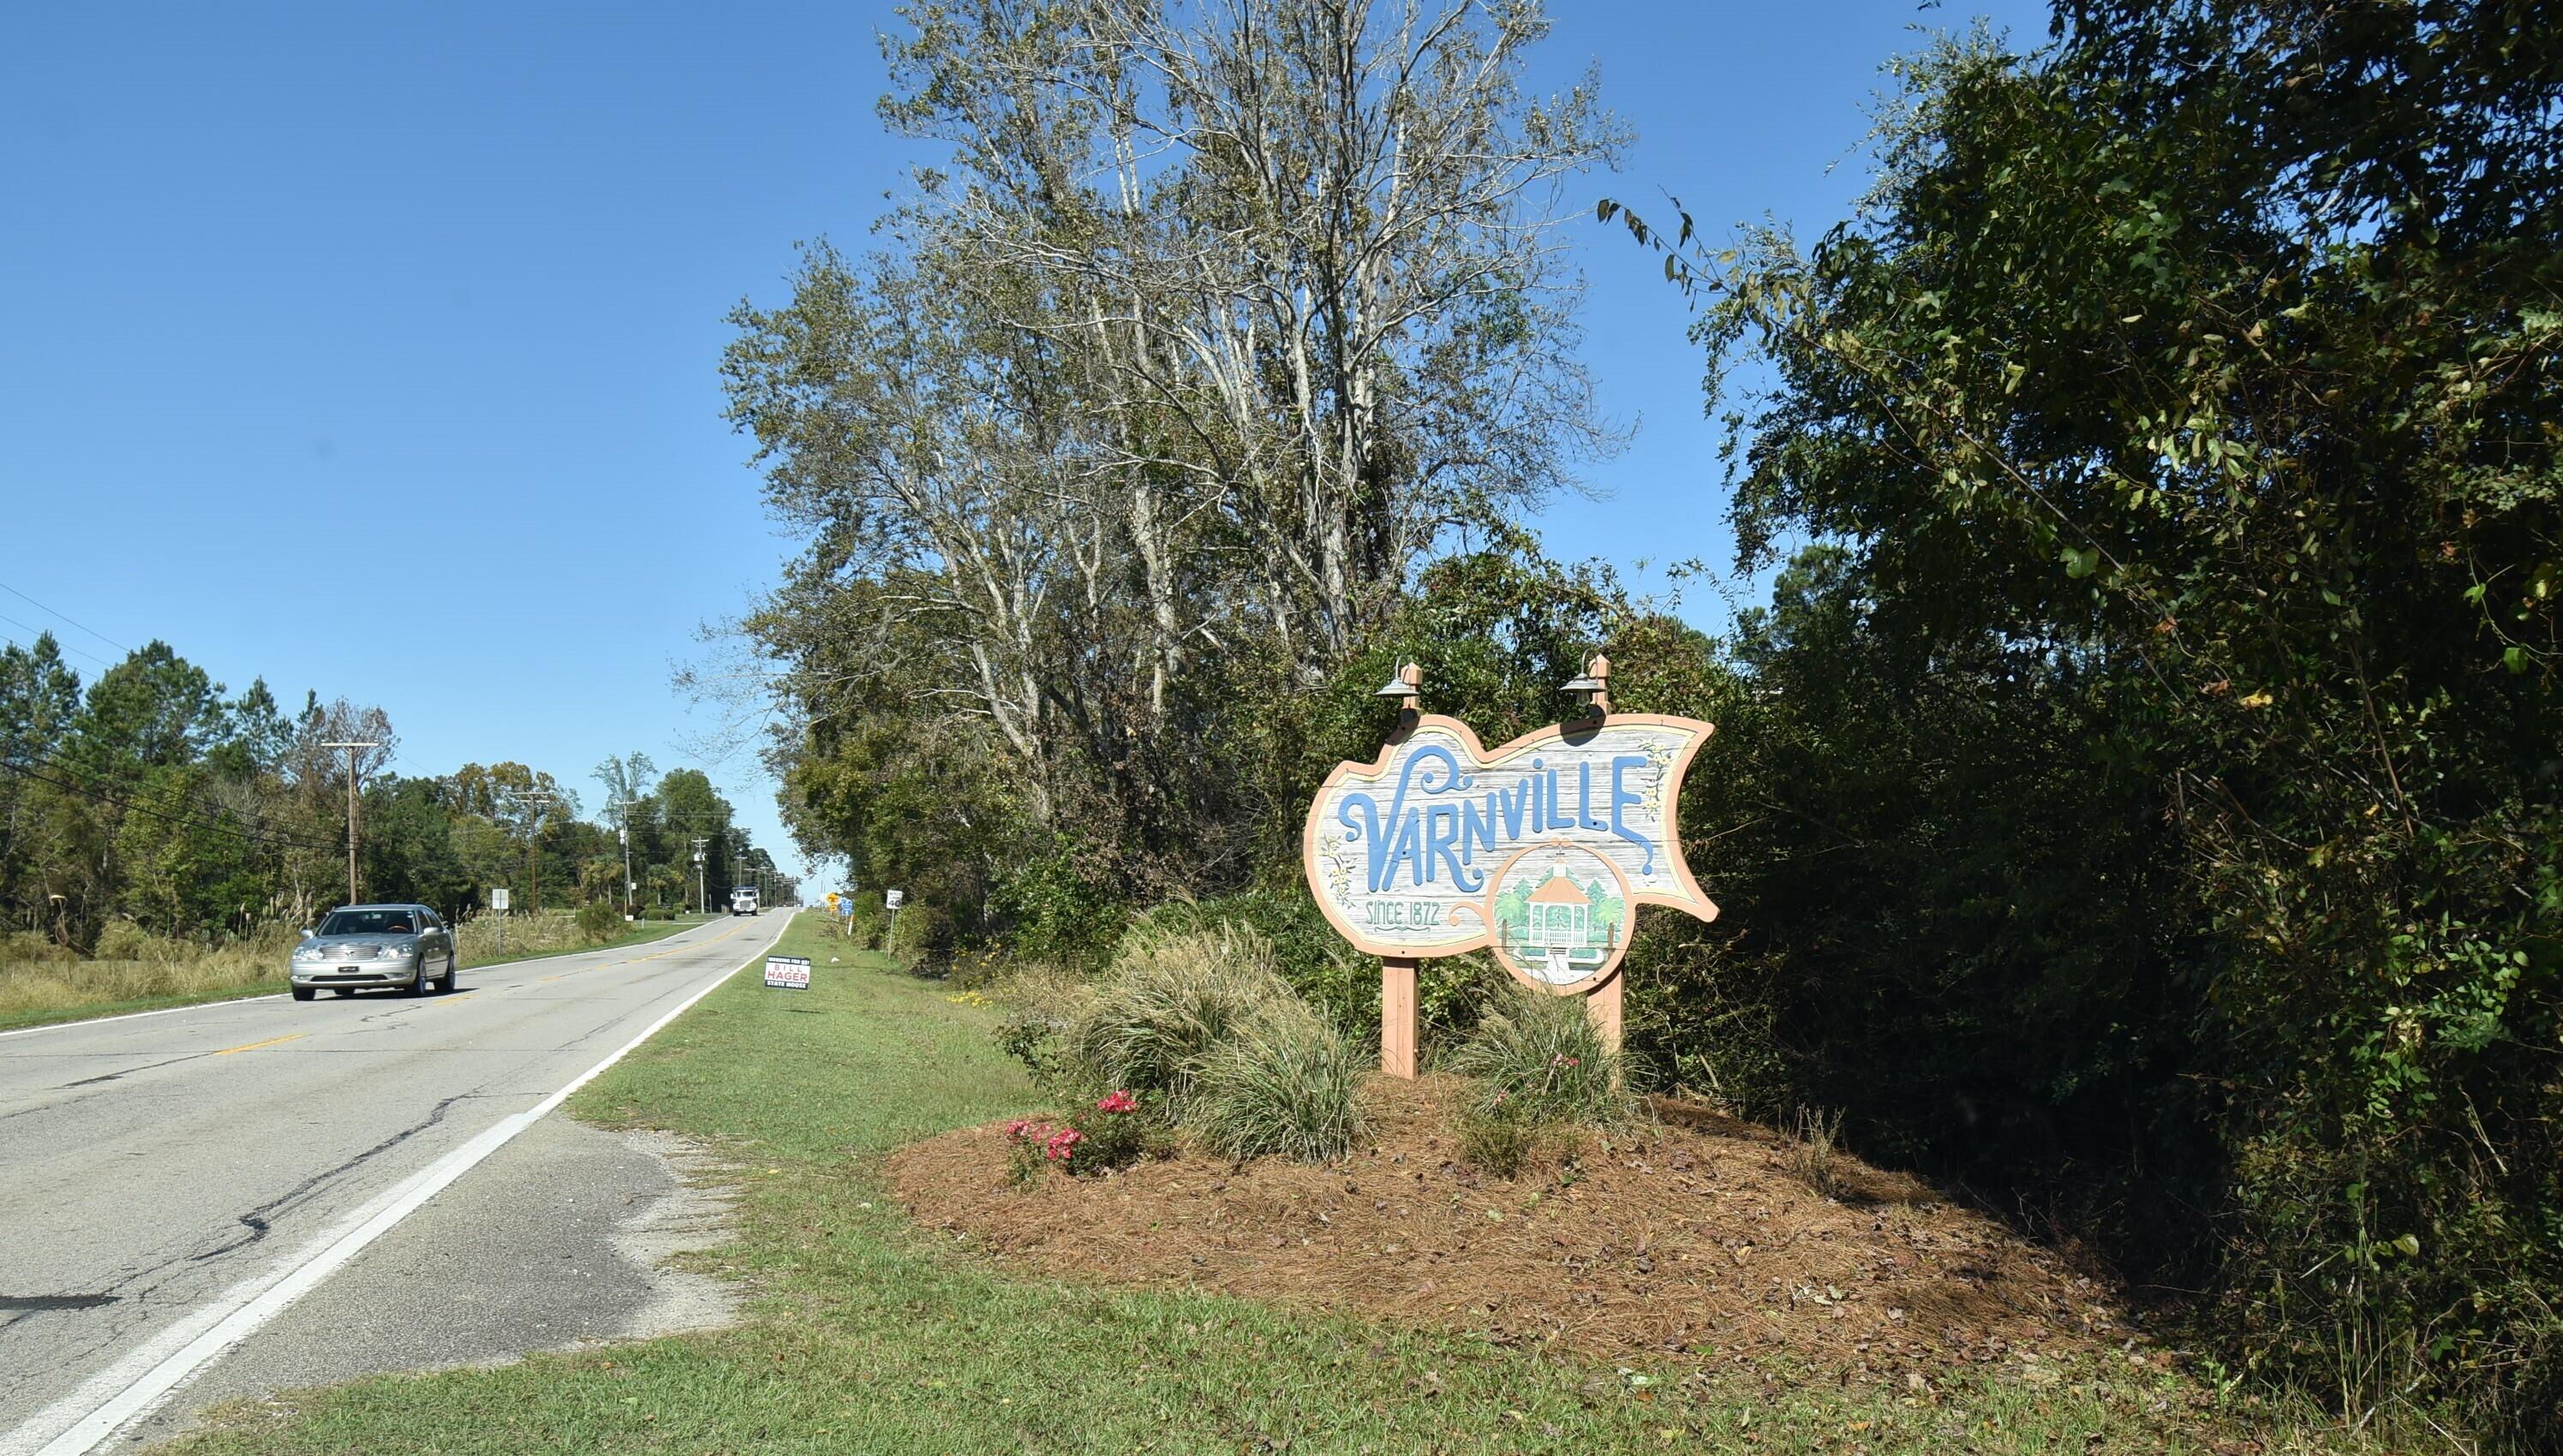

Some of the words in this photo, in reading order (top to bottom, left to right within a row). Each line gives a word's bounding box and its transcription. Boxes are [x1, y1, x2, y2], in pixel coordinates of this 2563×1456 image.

[1338, 744, 1653, 892] VARNVILLE
[1365, 900, 1404, 924] SINCE
[1409, 902, 1440, 925] 1872
[768, 970, 807, 982] HAGER
